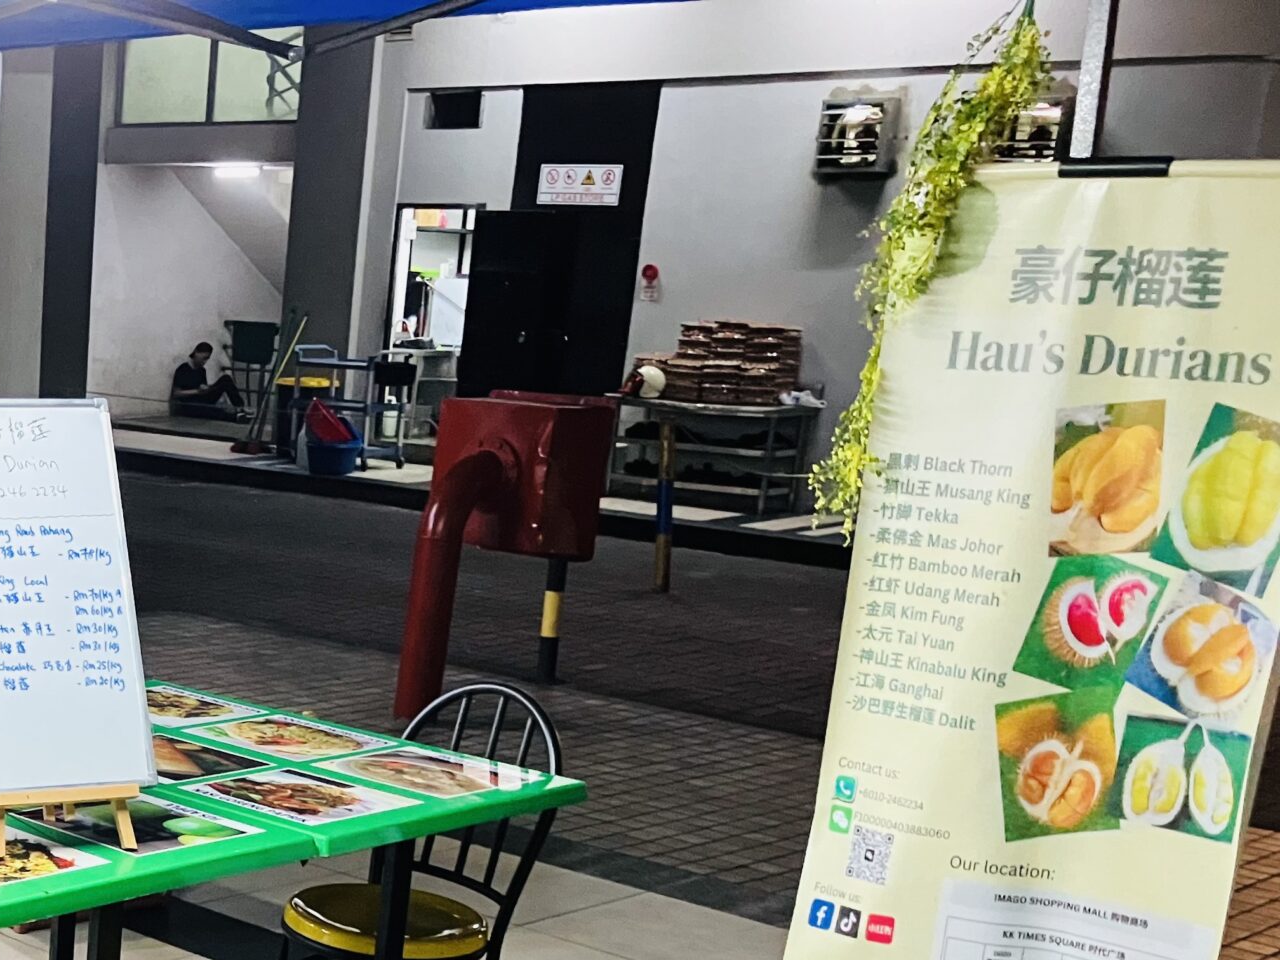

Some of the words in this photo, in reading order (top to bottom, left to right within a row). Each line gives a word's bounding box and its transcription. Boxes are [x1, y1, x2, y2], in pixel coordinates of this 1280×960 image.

[1008, 244, 1229, 310] 豪仔榴莲
[946, 329, 1065, 376] Hau's
[1078, 334, 1272, 386] Durians
[3, 454, 59, 474] Durian
[923, 456, 966, 474] Black
[969, 460, 1013, 477] Thorn
[935, 483, 993, 506] Musang
[996, 488, 1032, 509] King
[915, 506, 959, 525] Tekka
[927, 533, 957, 551] Mas
[960, 537, 1004, 556] Johor
[24, 574, 48, 587] Local
[908, 556, 968, 577] Bamboo
[971, 565, 1022, 584] Merah
[904, 581, 950, 604] Udang
[953, 588, 1001, 608] Merah
[900, 605, 928, 623] Kim
[930, 609, 965, 632] Fung
[897, 629, 917, 646] Tai
[920, 633, 955, 653] Yuan
[907, 655, 967, 680] Kinabalu
[971, 666, 1008, 688] King
[888, 678, 944, 702] Ganghai
[938, 712, 977, 732] Dalit
[838, 756, 882, 777] Contact
[884, 768, 900, 780] us:
[950, 855, 980, 872] Our
[984, 859, 1055, 881] location:
[814, 881, 846, 900] Follow
[994, 893, 1027, 905] IMAGO
[1029, 896, 1080, 913] SHOPPING
[1083, 906, 1108, 920] MALL
[1002, 930, 1014, 940] KK
[1018, 931, 1046, 942] TIMES
[1049, 935, 1086, 952] SQUARE
